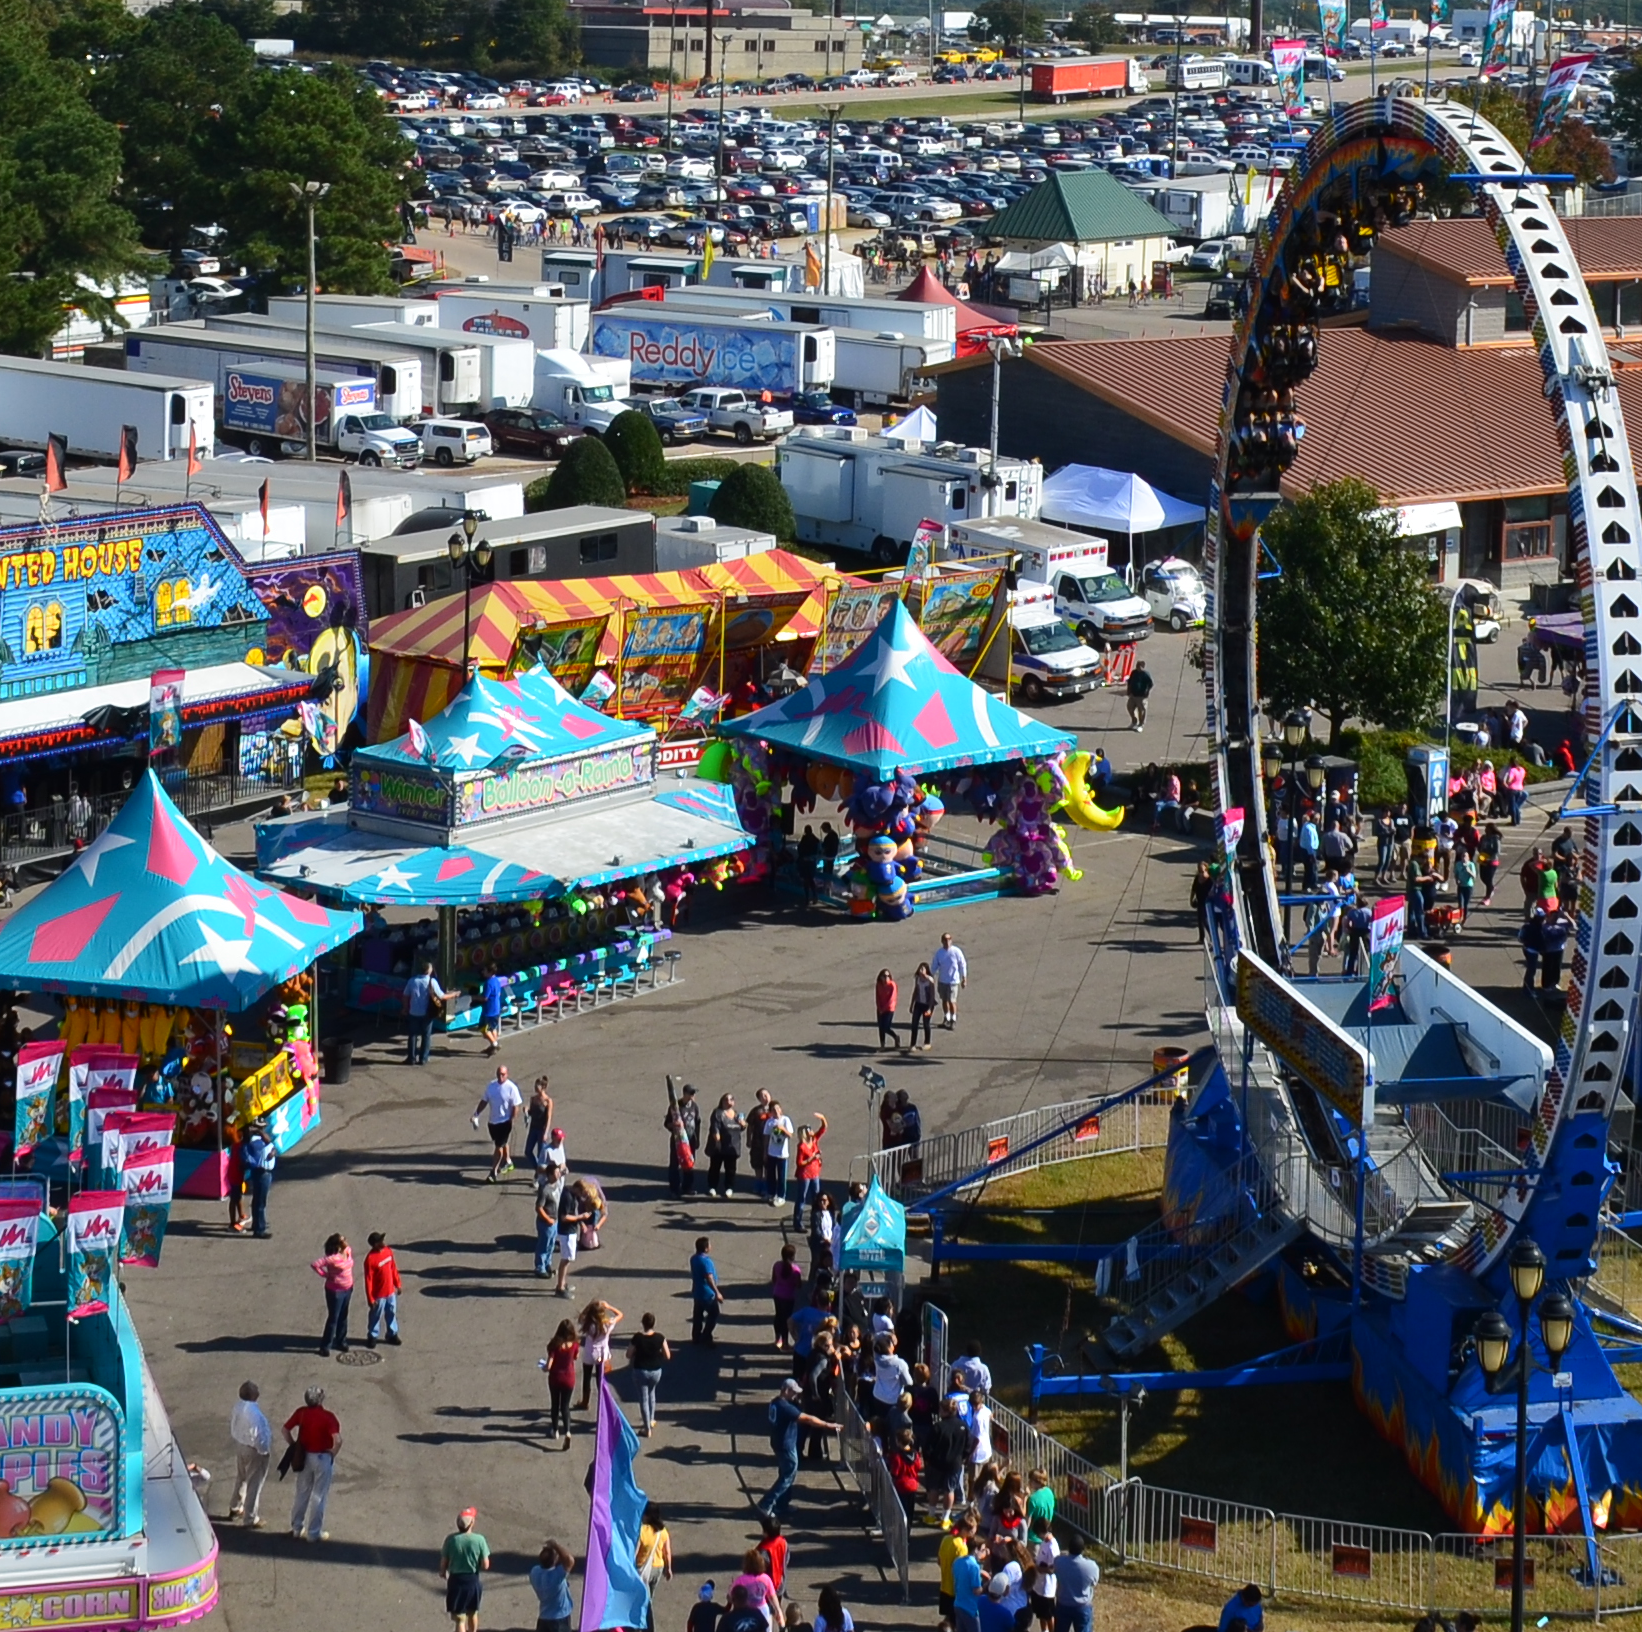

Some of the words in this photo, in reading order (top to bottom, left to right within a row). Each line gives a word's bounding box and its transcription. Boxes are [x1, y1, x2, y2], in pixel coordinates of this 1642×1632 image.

[630, 332, 714, 376] Reddy
[717, 350, 756, 372] ice
[228, 373, 274, 405] Stevens
[62, 538, 143, 582] HOUSE
[970, 548, 998, 566] EMS
[380, 772, 446, 809] Winner
[1431, 761, 1445, 815] ATM
[422, 809, 443, 821] RACE
[41, 1589, 131, 1619] CORN
[151, 1583, 185, 1611] SNO
